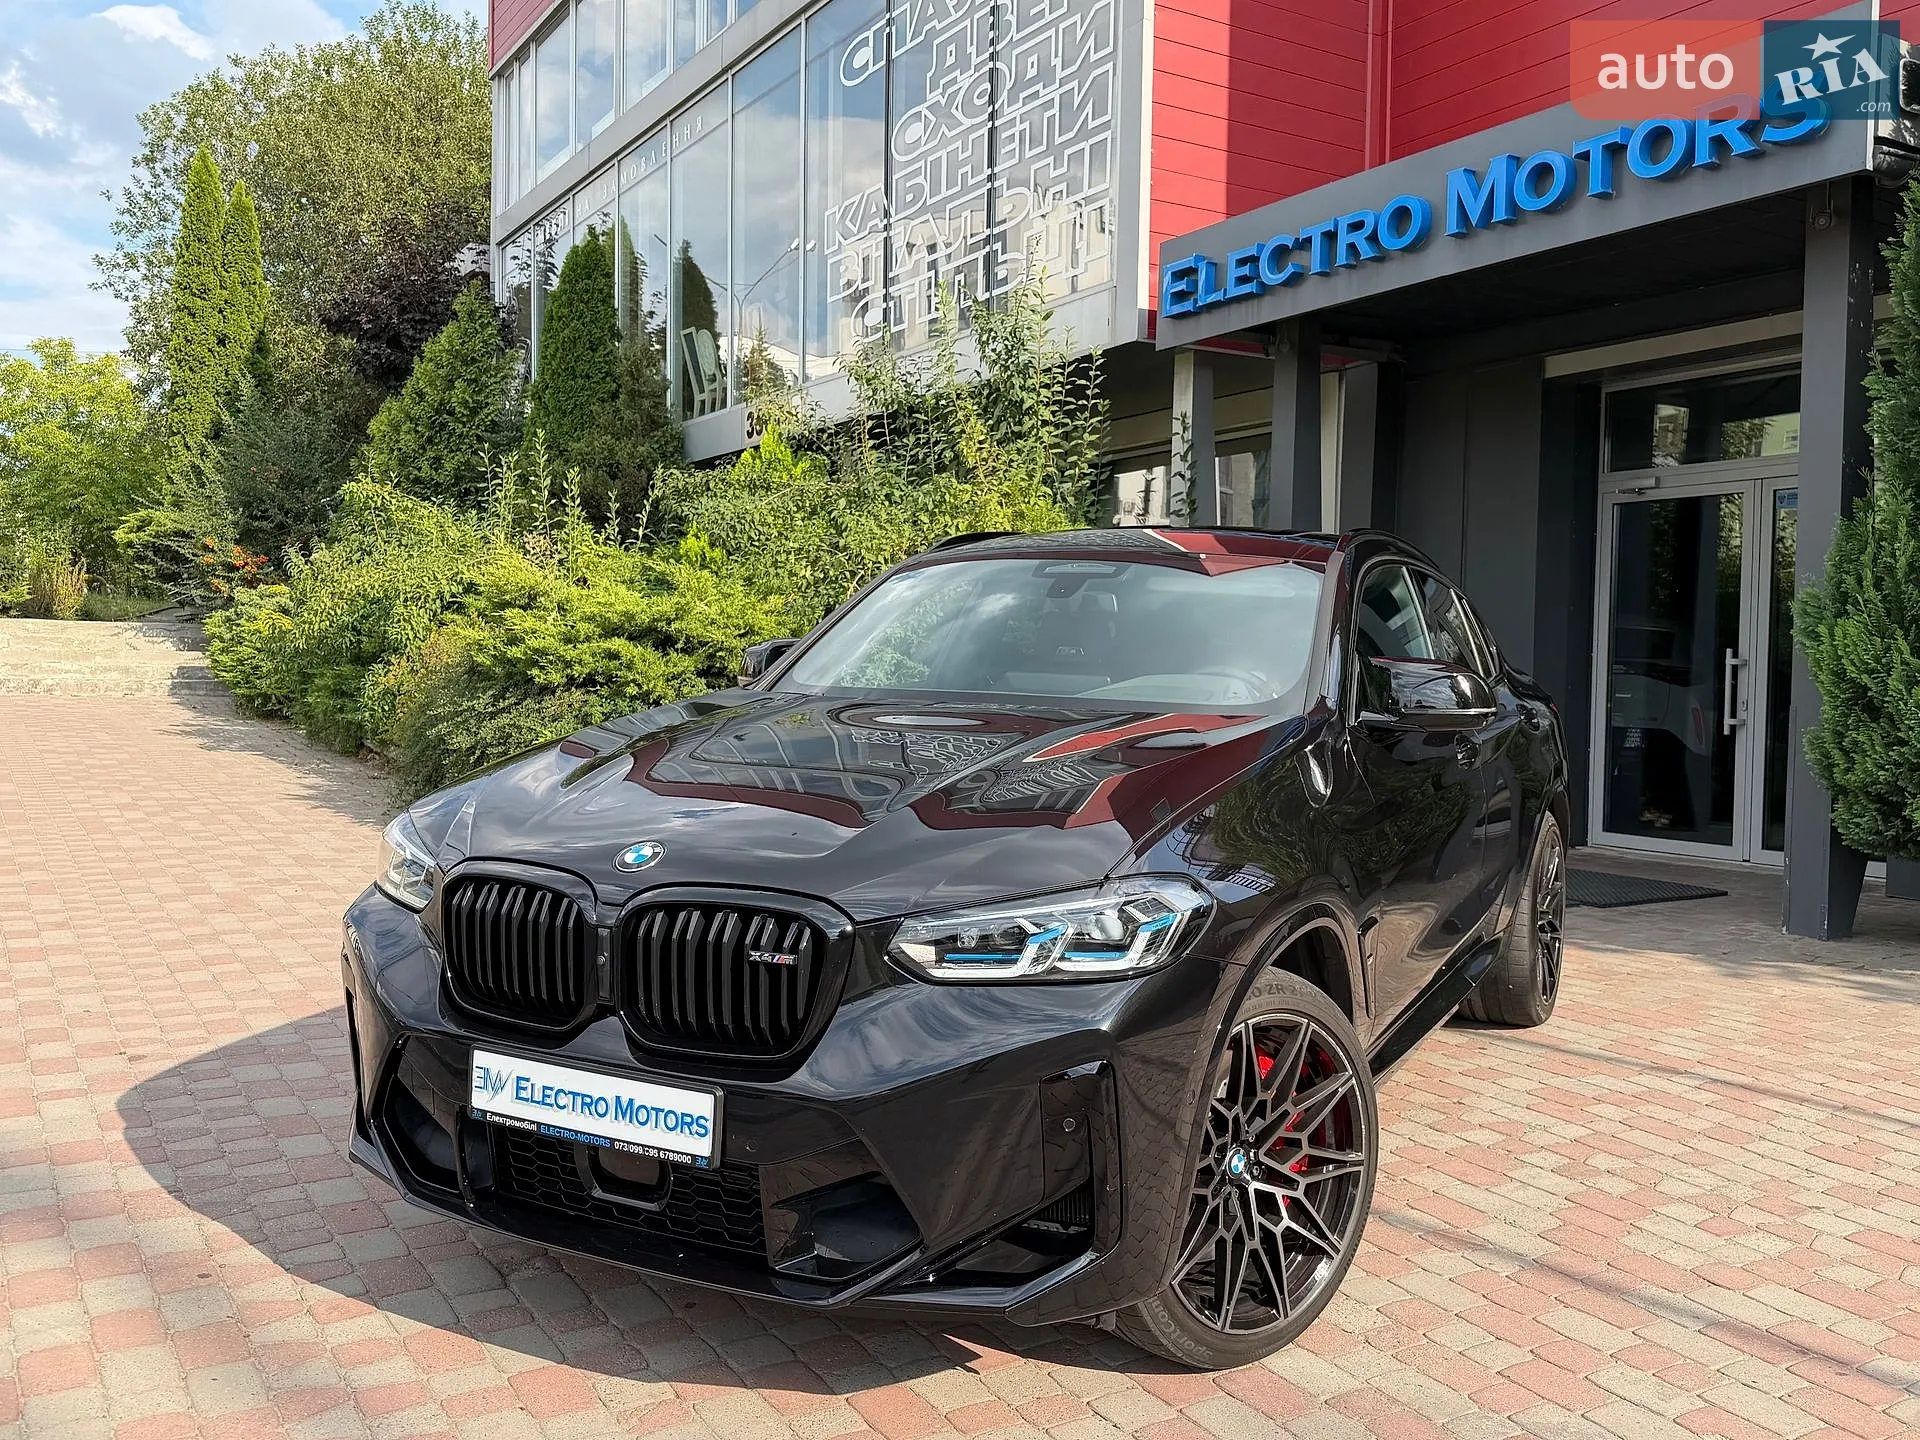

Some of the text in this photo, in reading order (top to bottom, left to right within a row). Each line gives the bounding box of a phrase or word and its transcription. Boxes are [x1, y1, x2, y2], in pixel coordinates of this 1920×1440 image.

[891, 0, 1114, 162] СХОДИ
[602, 116, 703, 200] ЗАМОВЛЕННЯ
[1162, 70, 1832, 319] ELECTRO MOTORS
[486, 1112, 537, 1131] Електромобілі
[540, 1125, 611, 1148] ELECTRO-MOTORS
[660, 1150, 692, 1164] 6789000
[514, 1076, 609, 1118] ELECTRO
[614, 1094, 710, 1138] MOTORS
